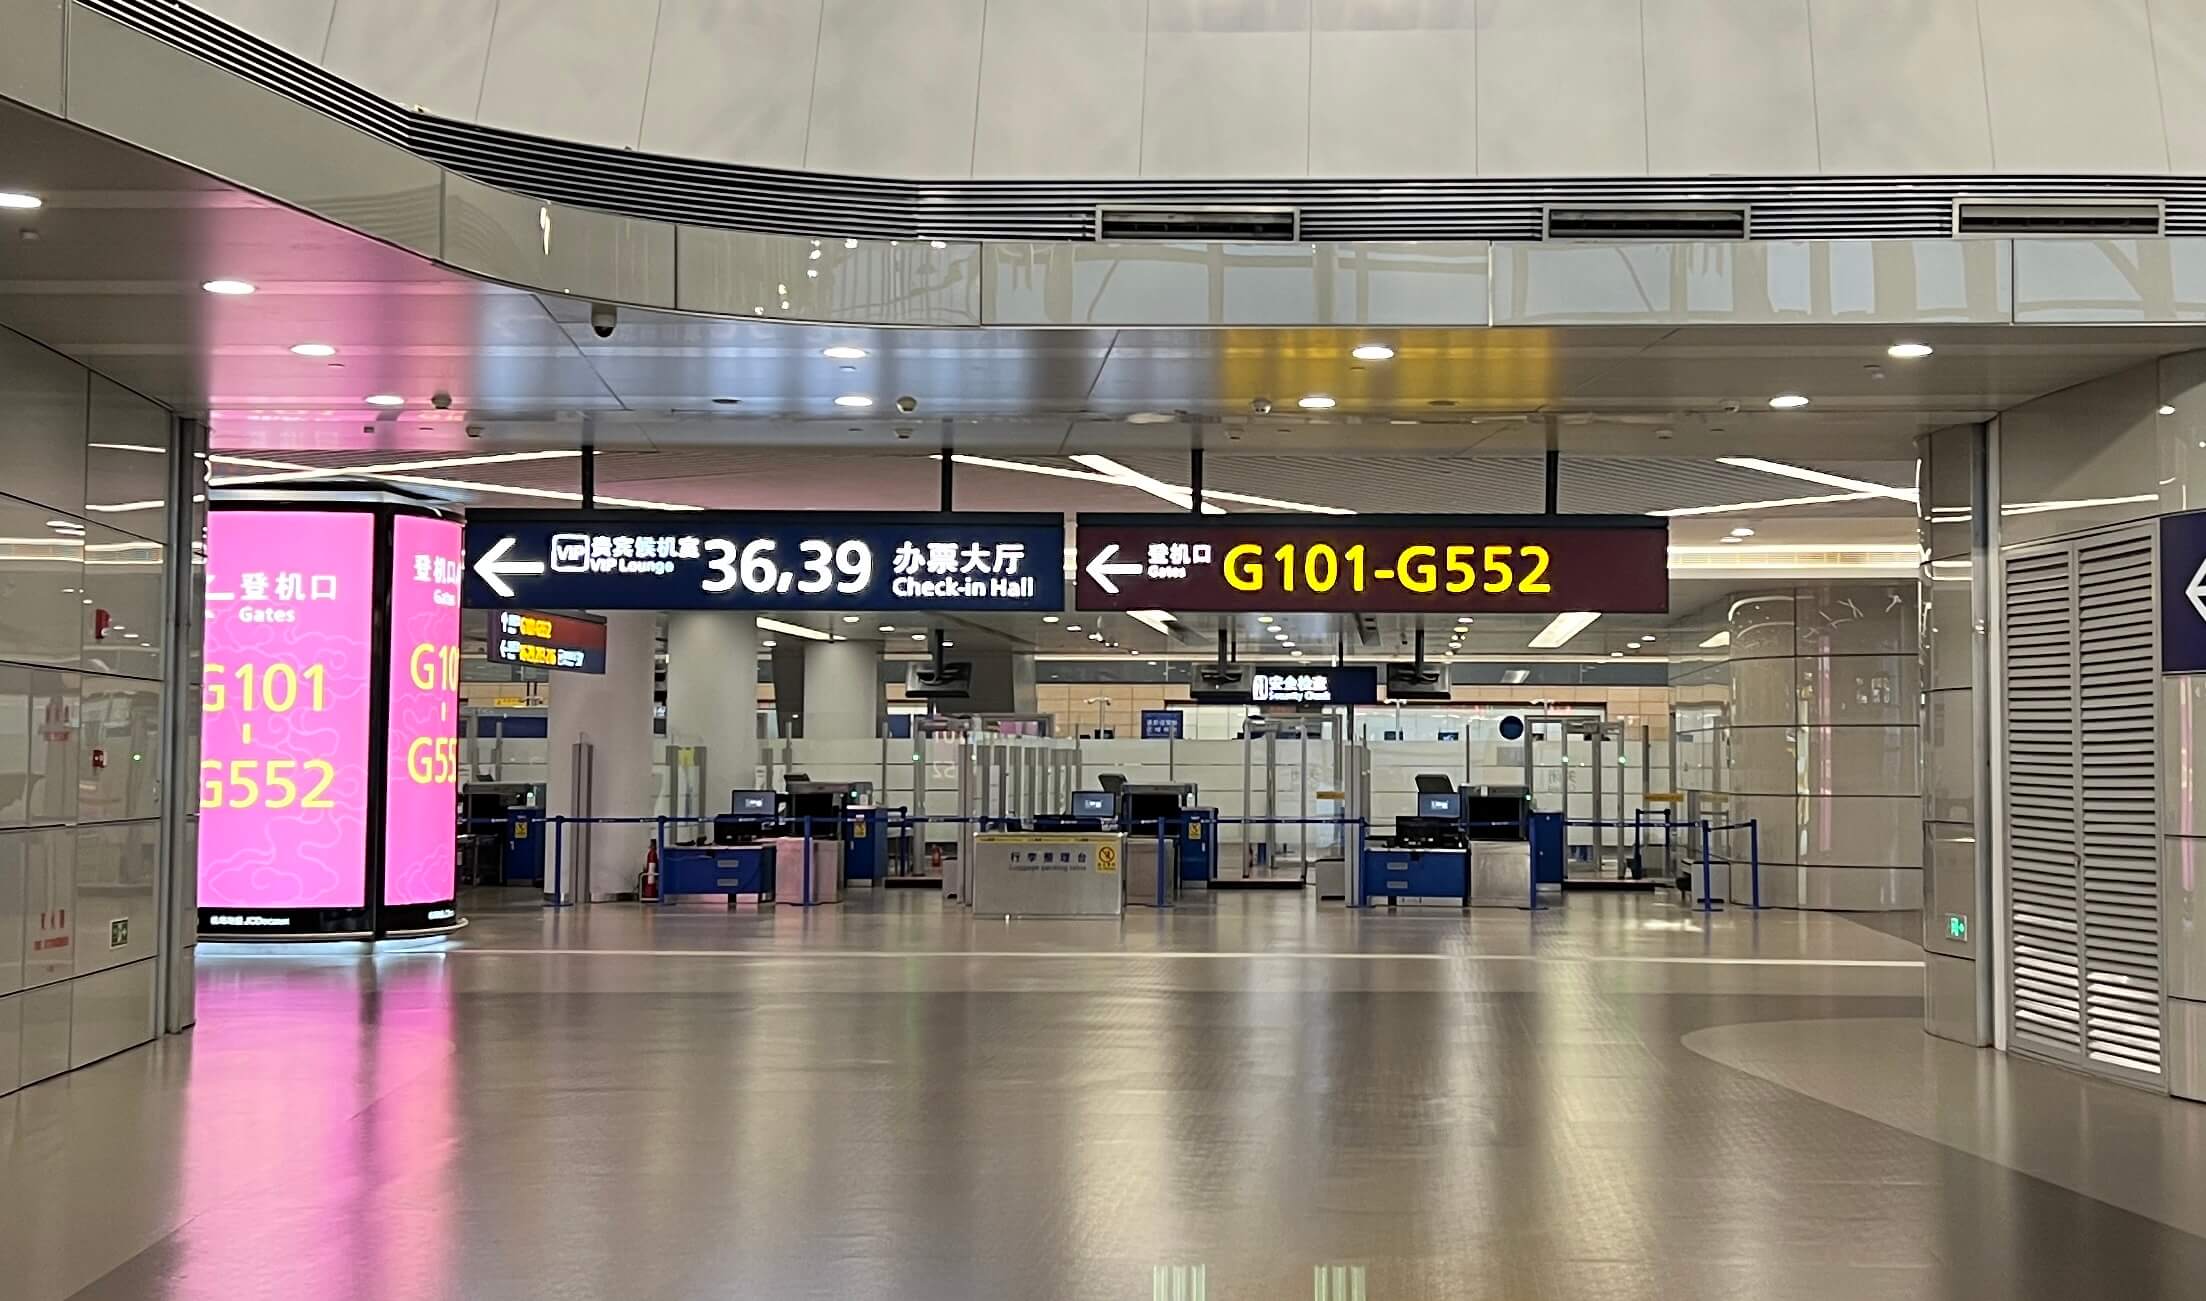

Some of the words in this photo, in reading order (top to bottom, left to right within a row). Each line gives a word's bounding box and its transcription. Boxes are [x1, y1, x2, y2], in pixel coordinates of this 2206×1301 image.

[556, 544, 586, 560] VIP
[590, 557, 618, 573] VIP
[618, 558, 675, 575] Lounge
[702, 539, 872, 594] 36,39
[892, 541, 1025, 574] 办票大厅
[1147, 542, 1211, 565] 登机口
[1223, 543, 1552, 593] G101-G552
[240, 572, 337, 601] 登机口
[892, 576, 987, 597] Check-in
[990, 577, 1034, 597] Hall
[239, 606, 296, 623] Gates
[203, 663, 326, 712] G101
[200, 759, 336, 809] G552
